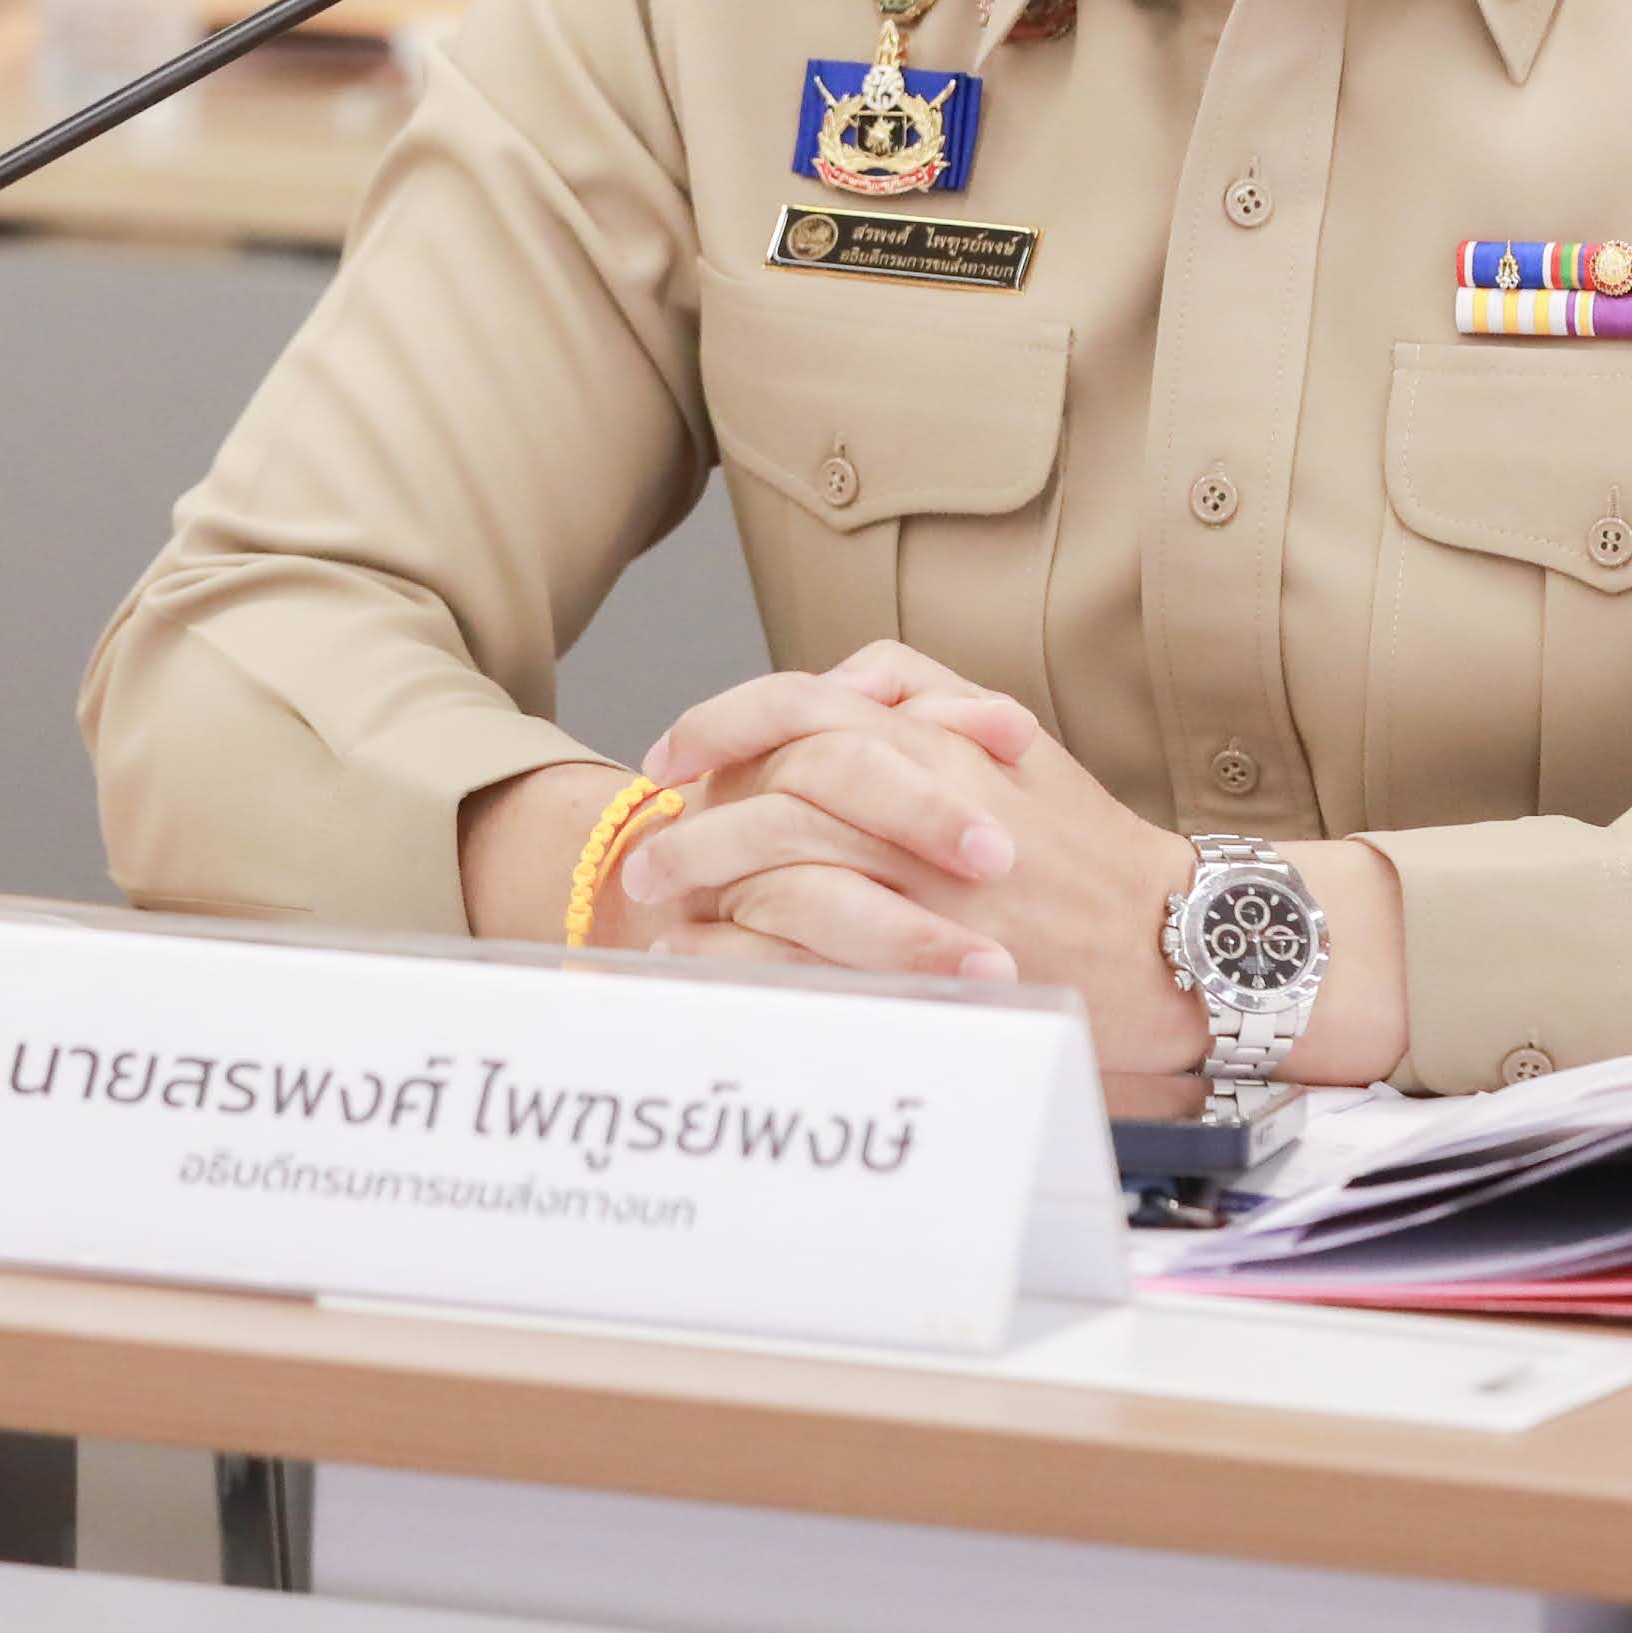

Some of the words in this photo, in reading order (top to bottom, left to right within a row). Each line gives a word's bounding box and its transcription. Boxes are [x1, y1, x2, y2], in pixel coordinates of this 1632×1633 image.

[8, 1041, 455, 1130] นายสรพงศ์
[472, 1057, 925, 1173] ไพฑูรย์พงษ์
[177, 1146, 697, 1231] อธิบดีกรมการขนส่งทางบก
